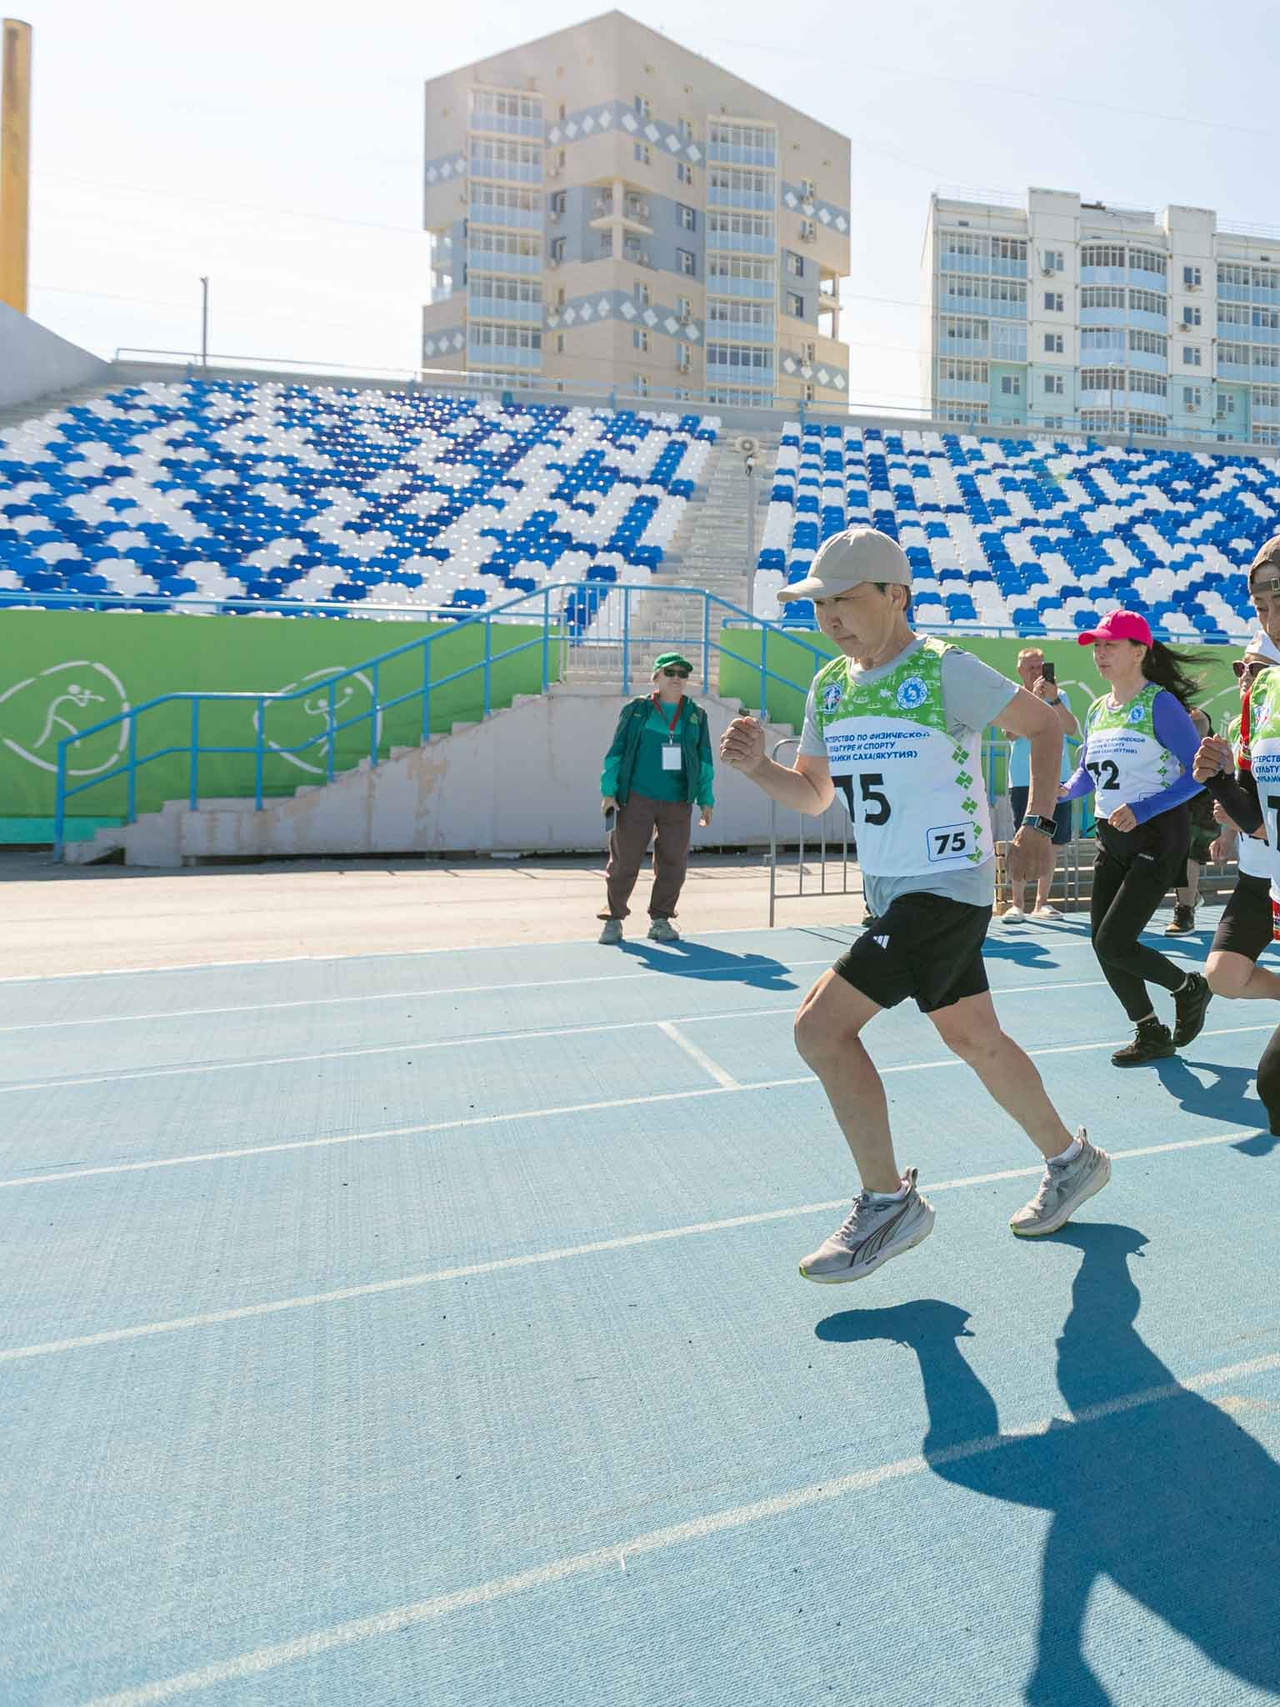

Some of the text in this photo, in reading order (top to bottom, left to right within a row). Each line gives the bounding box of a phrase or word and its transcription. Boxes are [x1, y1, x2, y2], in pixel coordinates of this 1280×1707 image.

[857, 734, 868, 742] ПО
[863, 741, 896, 751] СПОРТУ
[852, 750, 918, 761] САХА(ЯКУТИЯ)
[934, 832, 966, 854] 75
